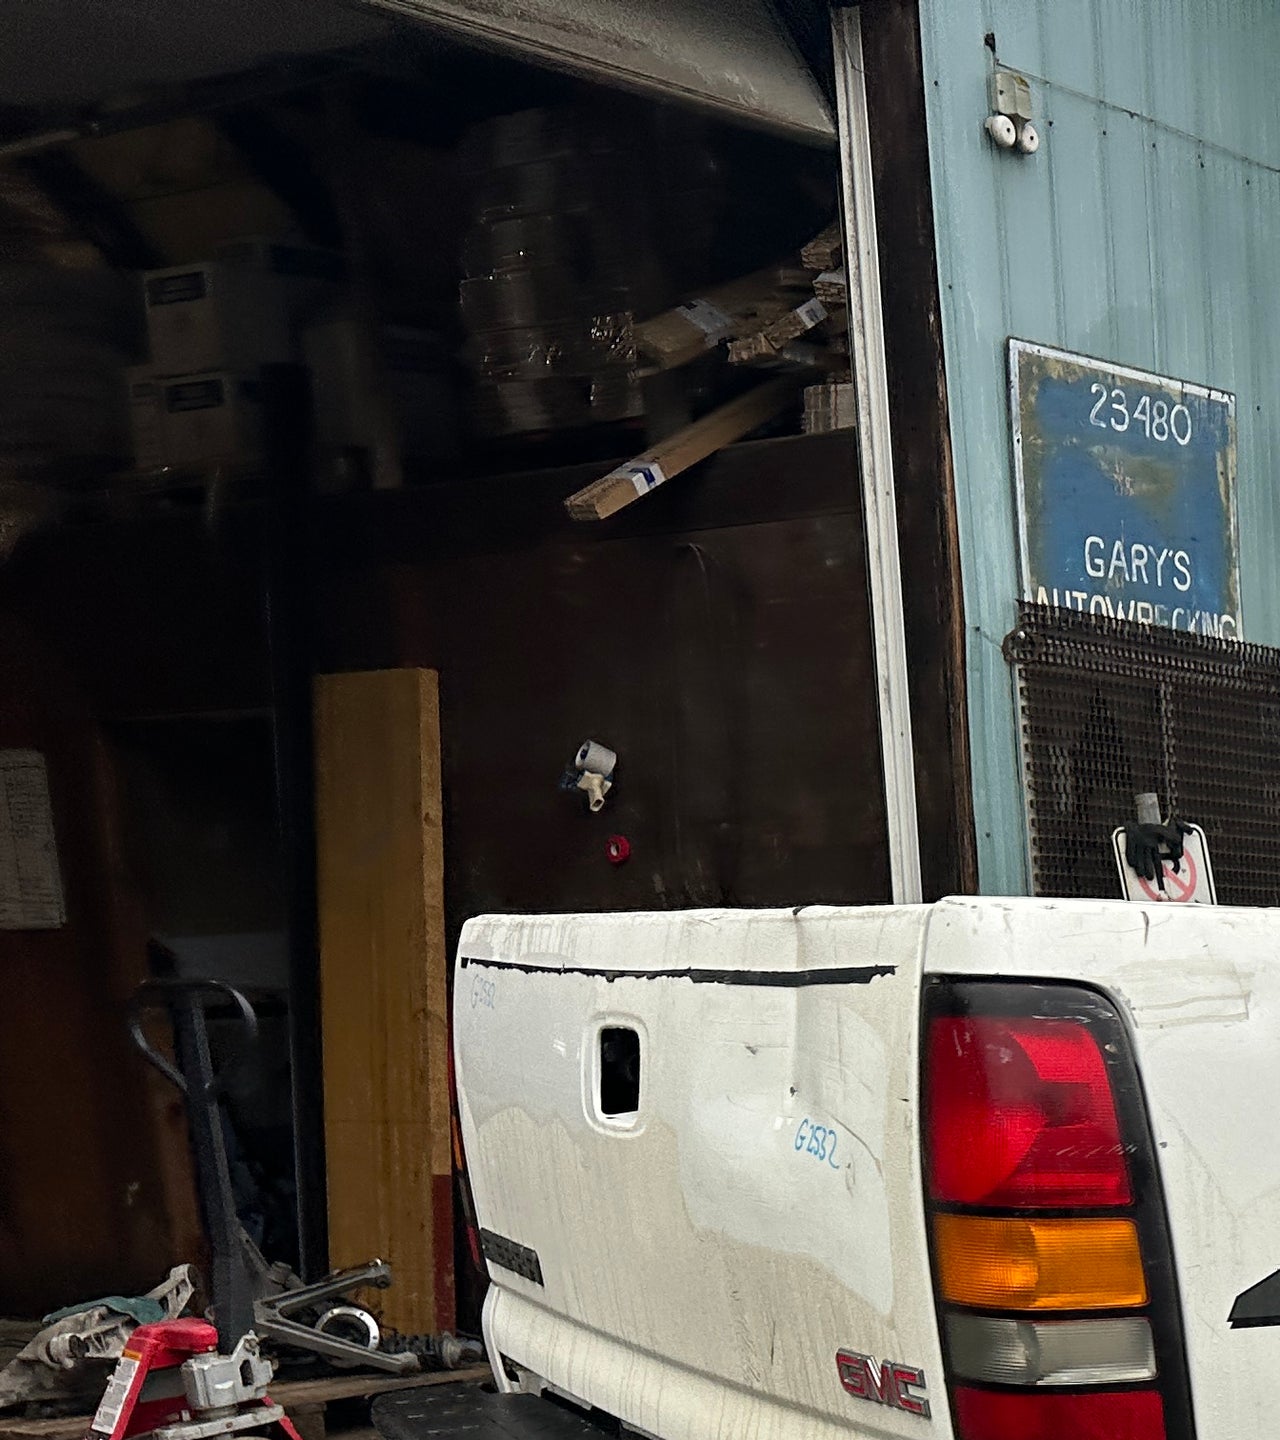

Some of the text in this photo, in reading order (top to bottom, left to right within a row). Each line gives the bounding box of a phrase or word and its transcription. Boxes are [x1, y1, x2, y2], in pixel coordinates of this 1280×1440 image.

[1089, 382, 1193, 446] 23480
[1084, 535, 1191, 592] GARY'S
[794, 1118, 840, 1170] G2532
[836, 1348, 931, 1419] GMC
